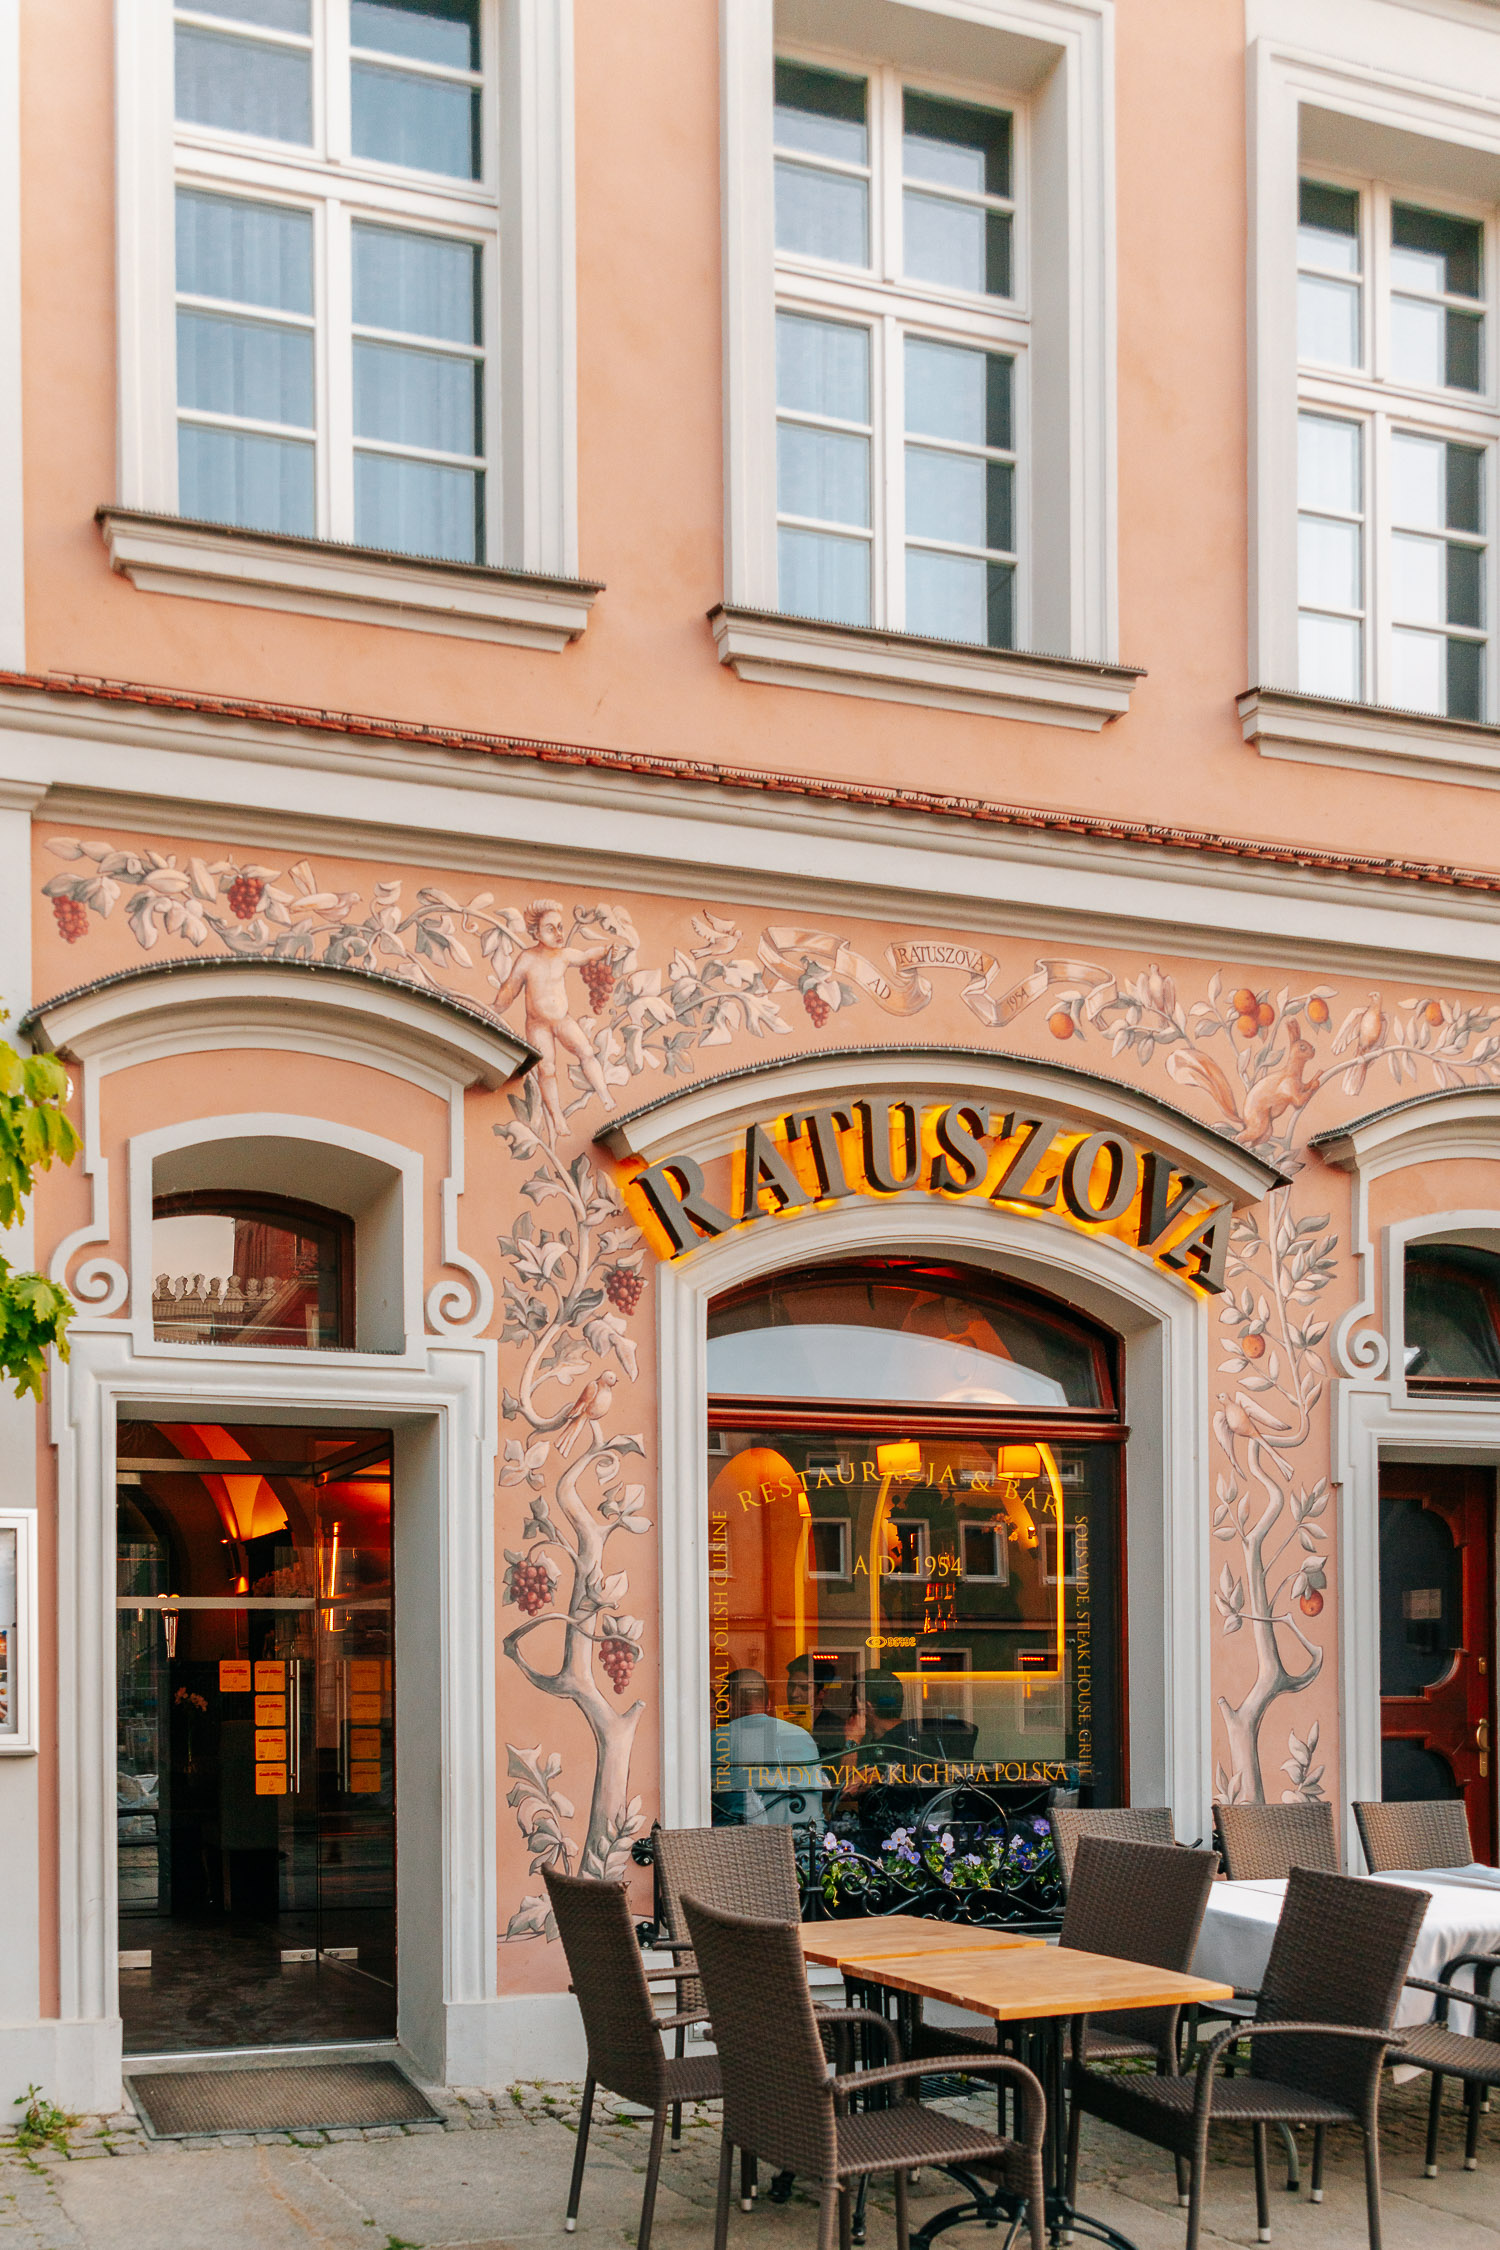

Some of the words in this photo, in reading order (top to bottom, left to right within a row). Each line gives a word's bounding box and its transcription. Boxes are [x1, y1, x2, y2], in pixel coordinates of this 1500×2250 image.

[897, 946, 985, 972] RATUSZOVA
[868, 978, 892, 1000] AD
[1006, 986, 1029, 1012] 1954
[628, 1100, 1233, 1294] RATUSZOVA
[737, 1461, 957, 1512] RESTAURACJA
[970, 1470, 990, 1492] &
[1004, 1478, 1057, 1517] BAR
[712, 1510, 728, 1586] CUISINE
[913, 1555, 962, 1577] 1954
[713, 1592, 729, 1653] POLISH
[1077, 1611, 1091, 1661] STEAK
[714, 1661, 731, 1791] TRADITIONAL
[743, 1765, 883, 1790] TRADYCYJNA
[888, 1763, 989, 1784] KUCHNIA
[995, 1762, 1069, 1782] POLSKA
[1079, 1729, 1092, 1778] GRILL
